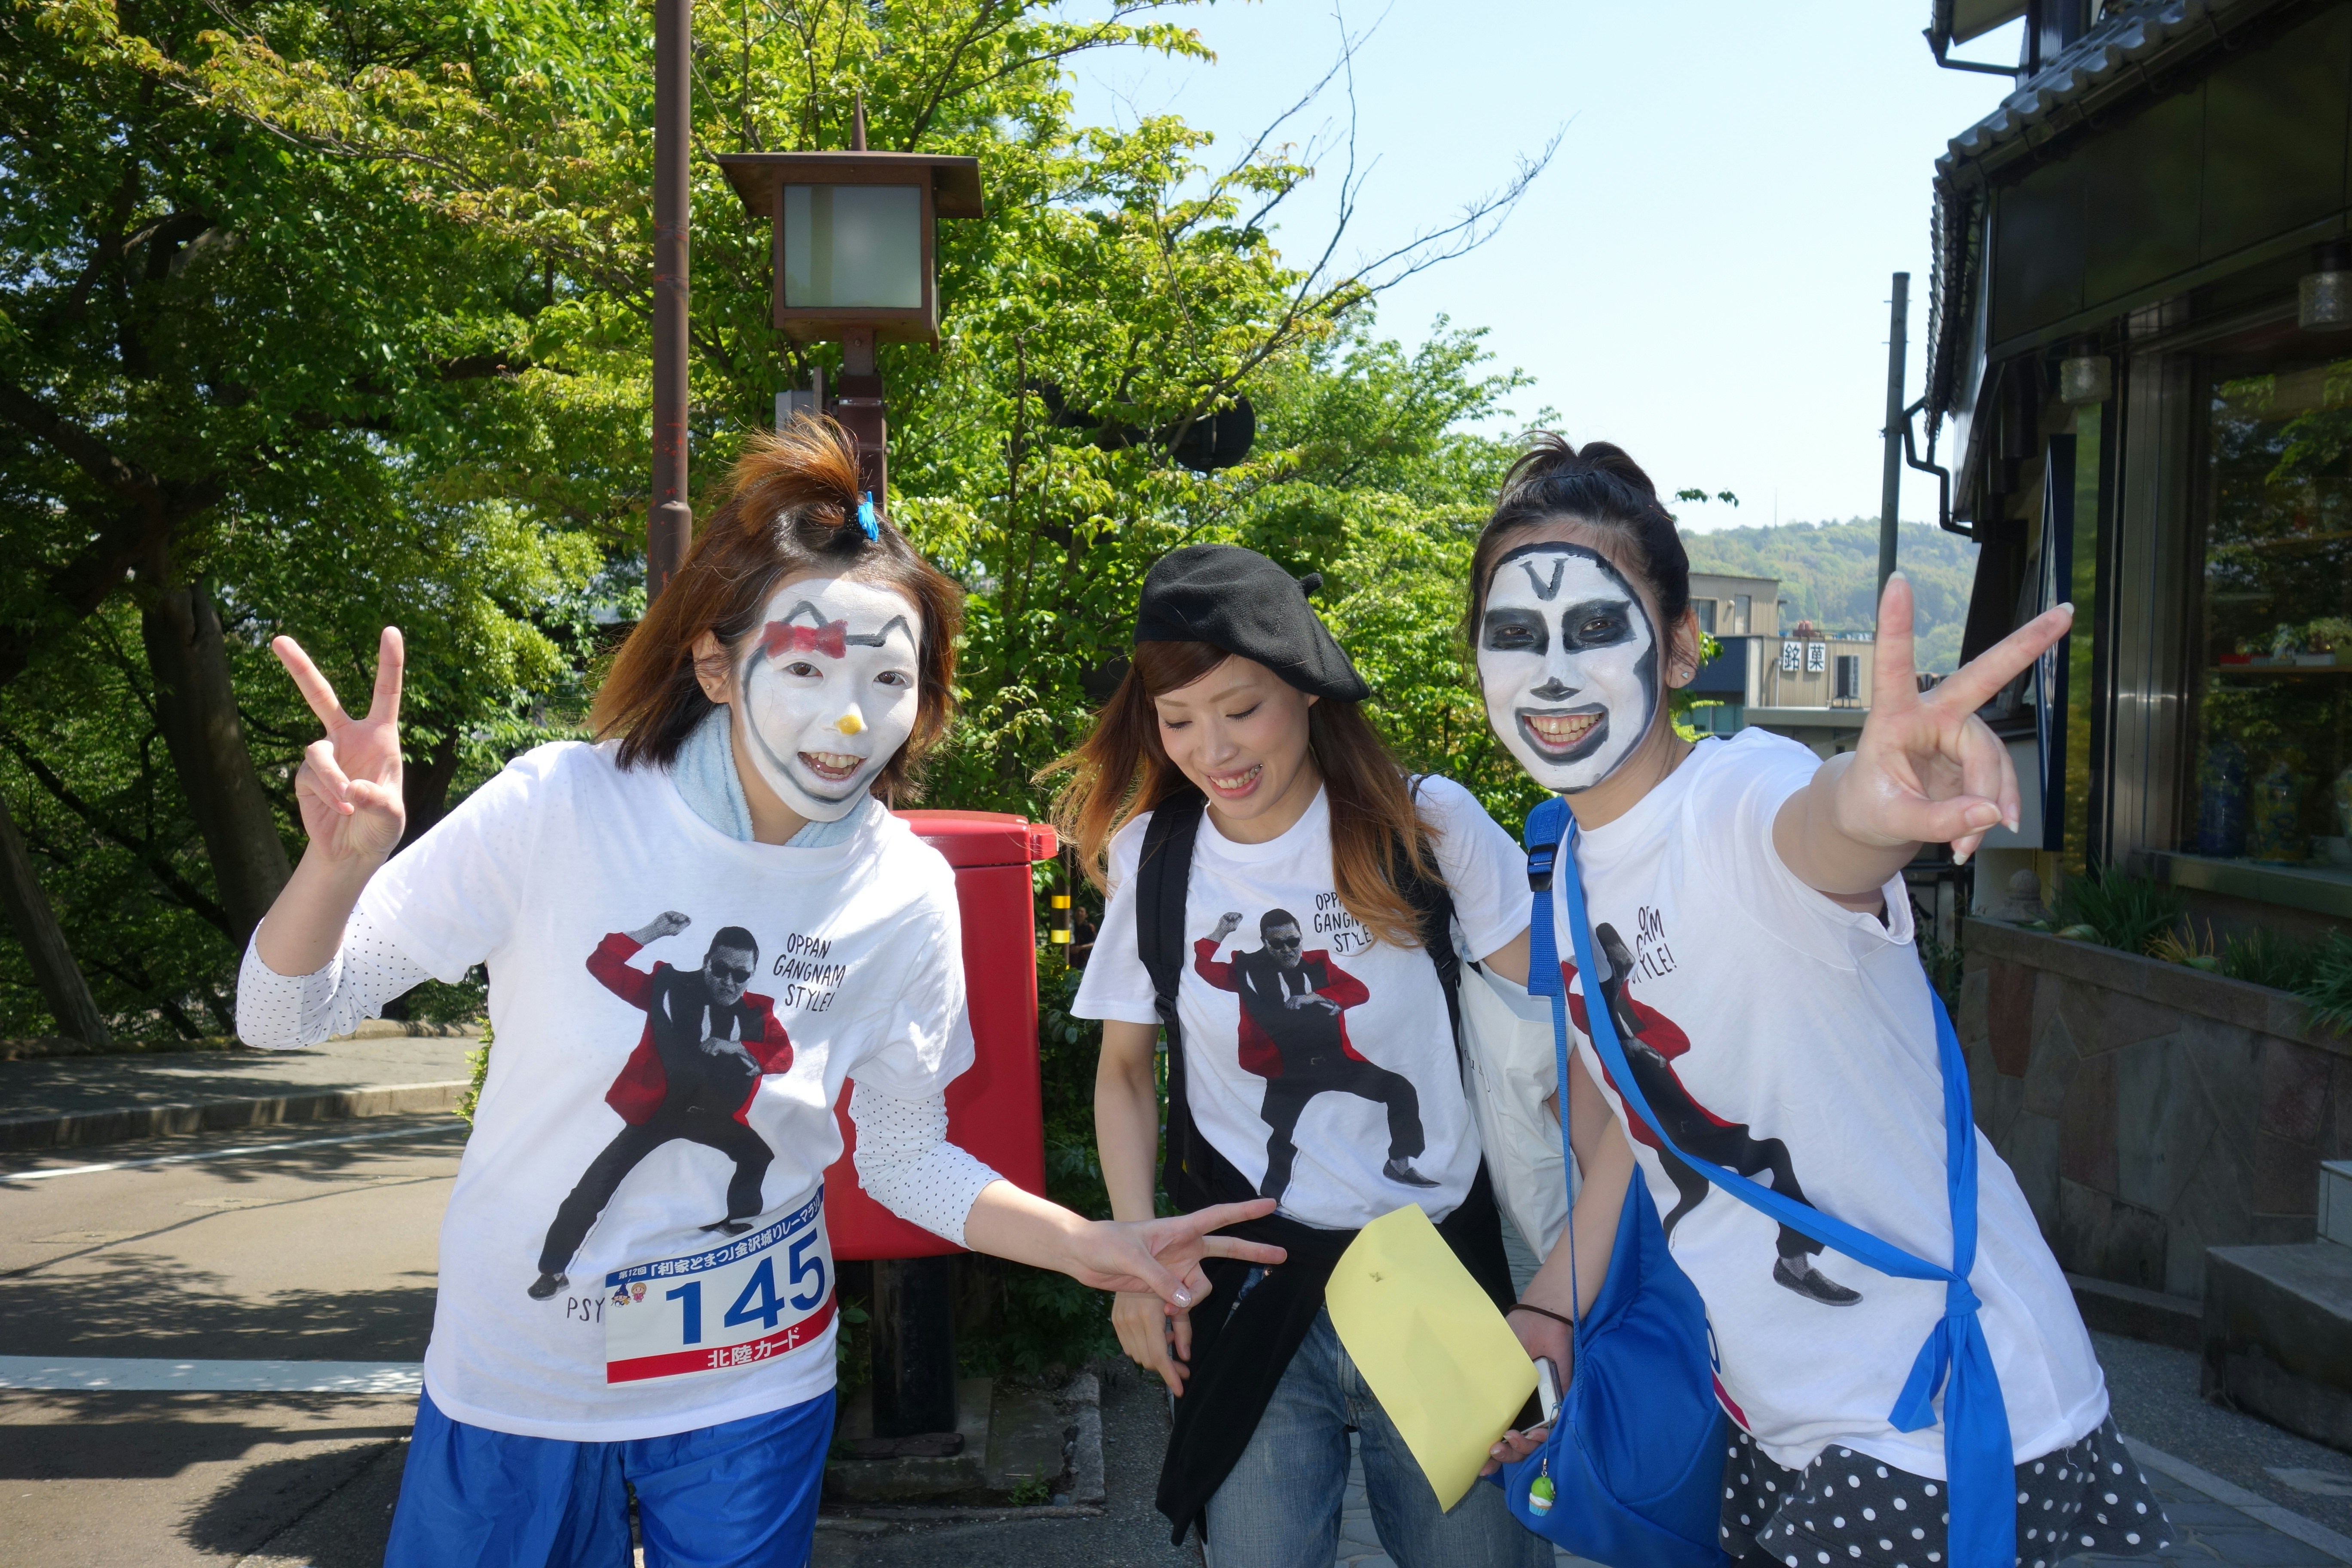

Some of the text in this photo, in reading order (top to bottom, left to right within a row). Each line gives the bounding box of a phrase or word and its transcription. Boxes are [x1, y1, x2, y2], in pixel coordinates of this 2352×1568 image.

[1785, 643, 1825, 671] 銘菓
[1316, 892, 1342, 911] OPP
[787, 933, 831, 959] OPPAN
[773, 954, 846, 988] GANGNAM
[785, 983, 836, 1012] STYLE!
[618, 1266, 646, 1280] 第12回
[666, 1227, 825, 1344] 145
[567, 1297, 605, 1323] PSY
[707, 1327, 800, 1368] 北陸カード
